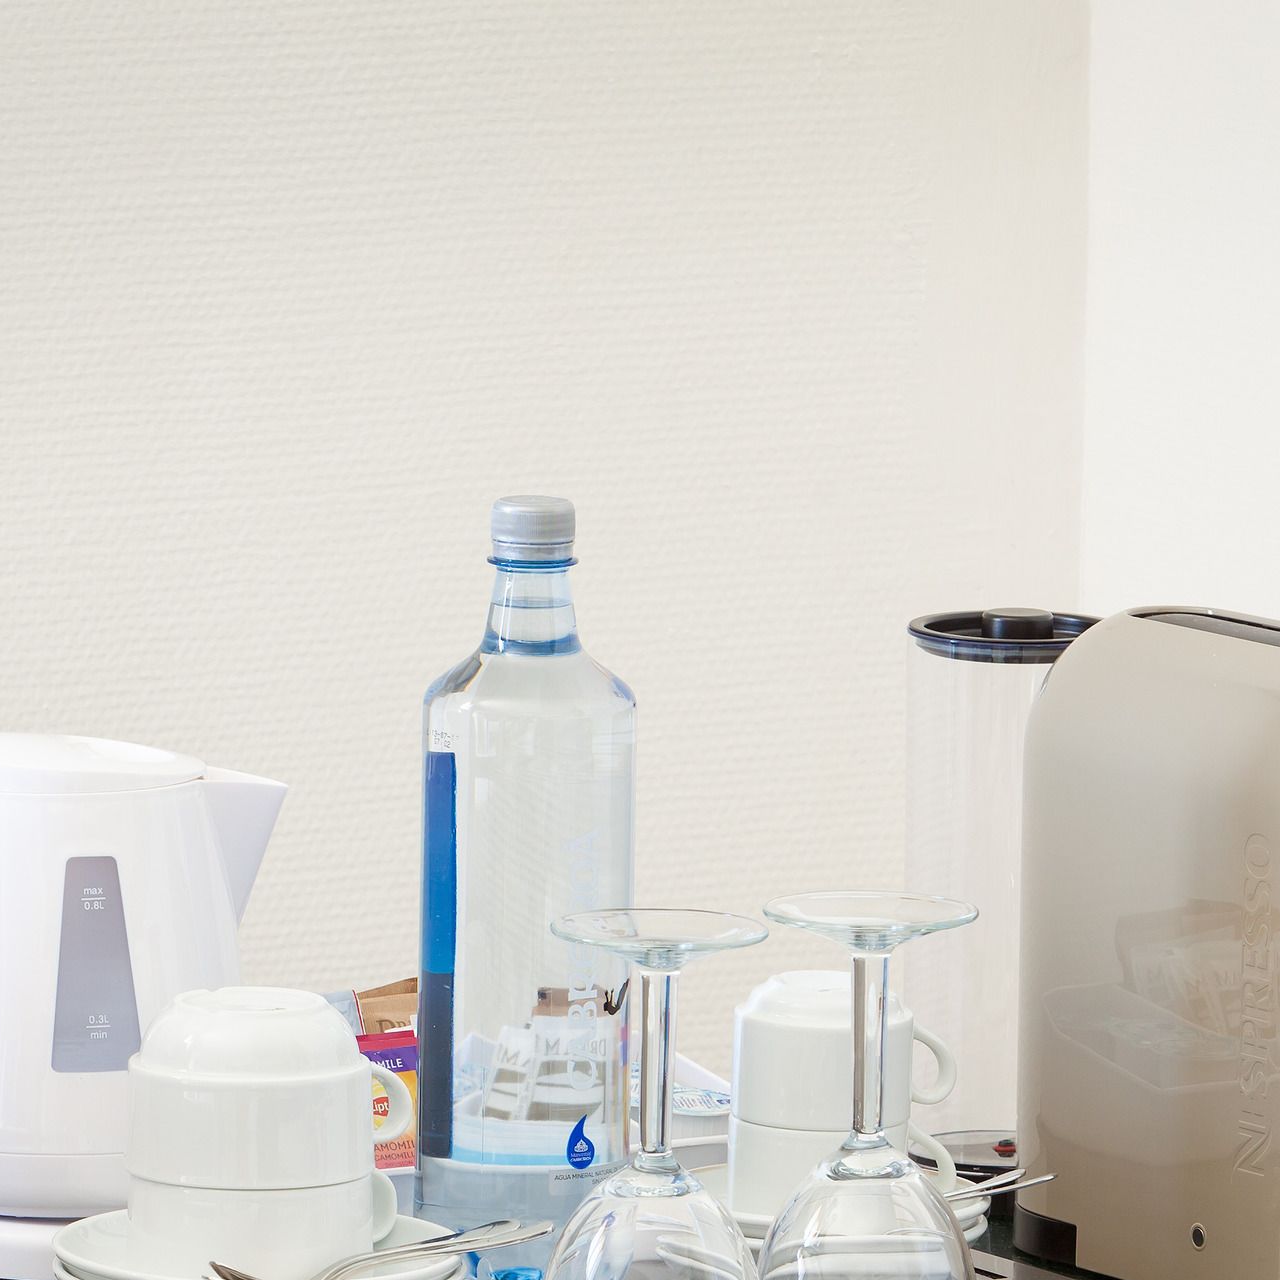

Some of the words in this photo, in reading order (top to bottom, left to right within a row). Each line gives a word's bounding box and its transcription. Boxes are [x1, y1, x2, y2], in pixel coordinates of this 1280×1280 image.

[84, 887, 104, 895] max
[84, 900, 105, 910] 0.8L
[88, 1014, 110, 1024] 0.3L
[90, 1030, 108, 1039] min
[373, 1058, 404, 1068] MILE
